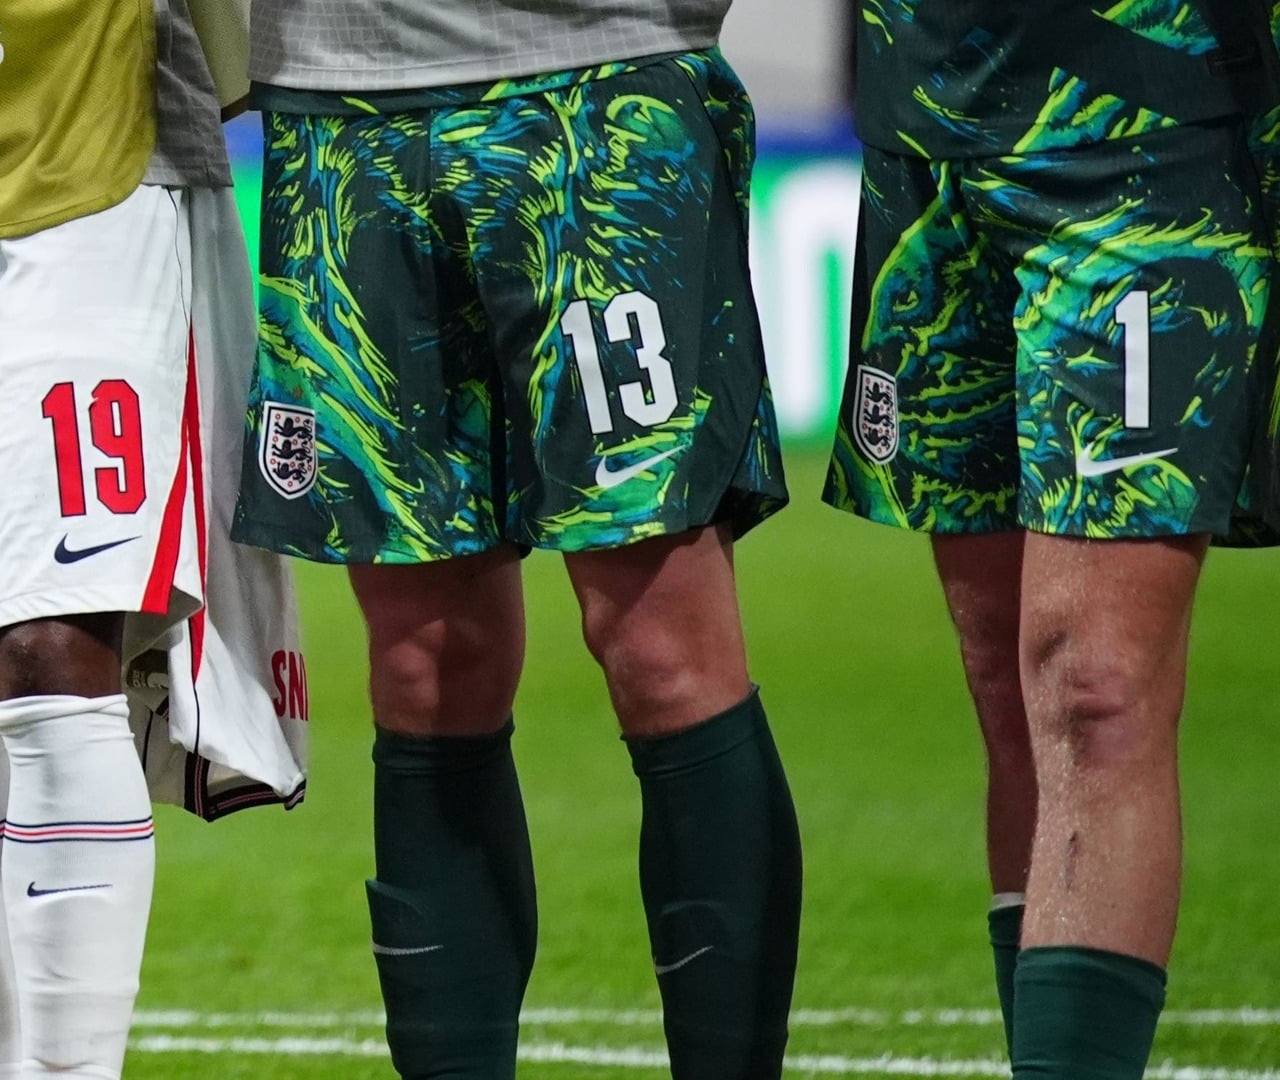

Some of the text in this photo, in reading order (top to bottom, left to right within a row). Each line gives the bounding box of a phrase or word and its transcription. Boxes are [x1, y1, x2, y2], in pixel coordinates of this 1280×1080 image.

[559, 289, 679, 435] 13
[1113, 289, 1150, 429] 1
[41, 378, 146, 518] 19
